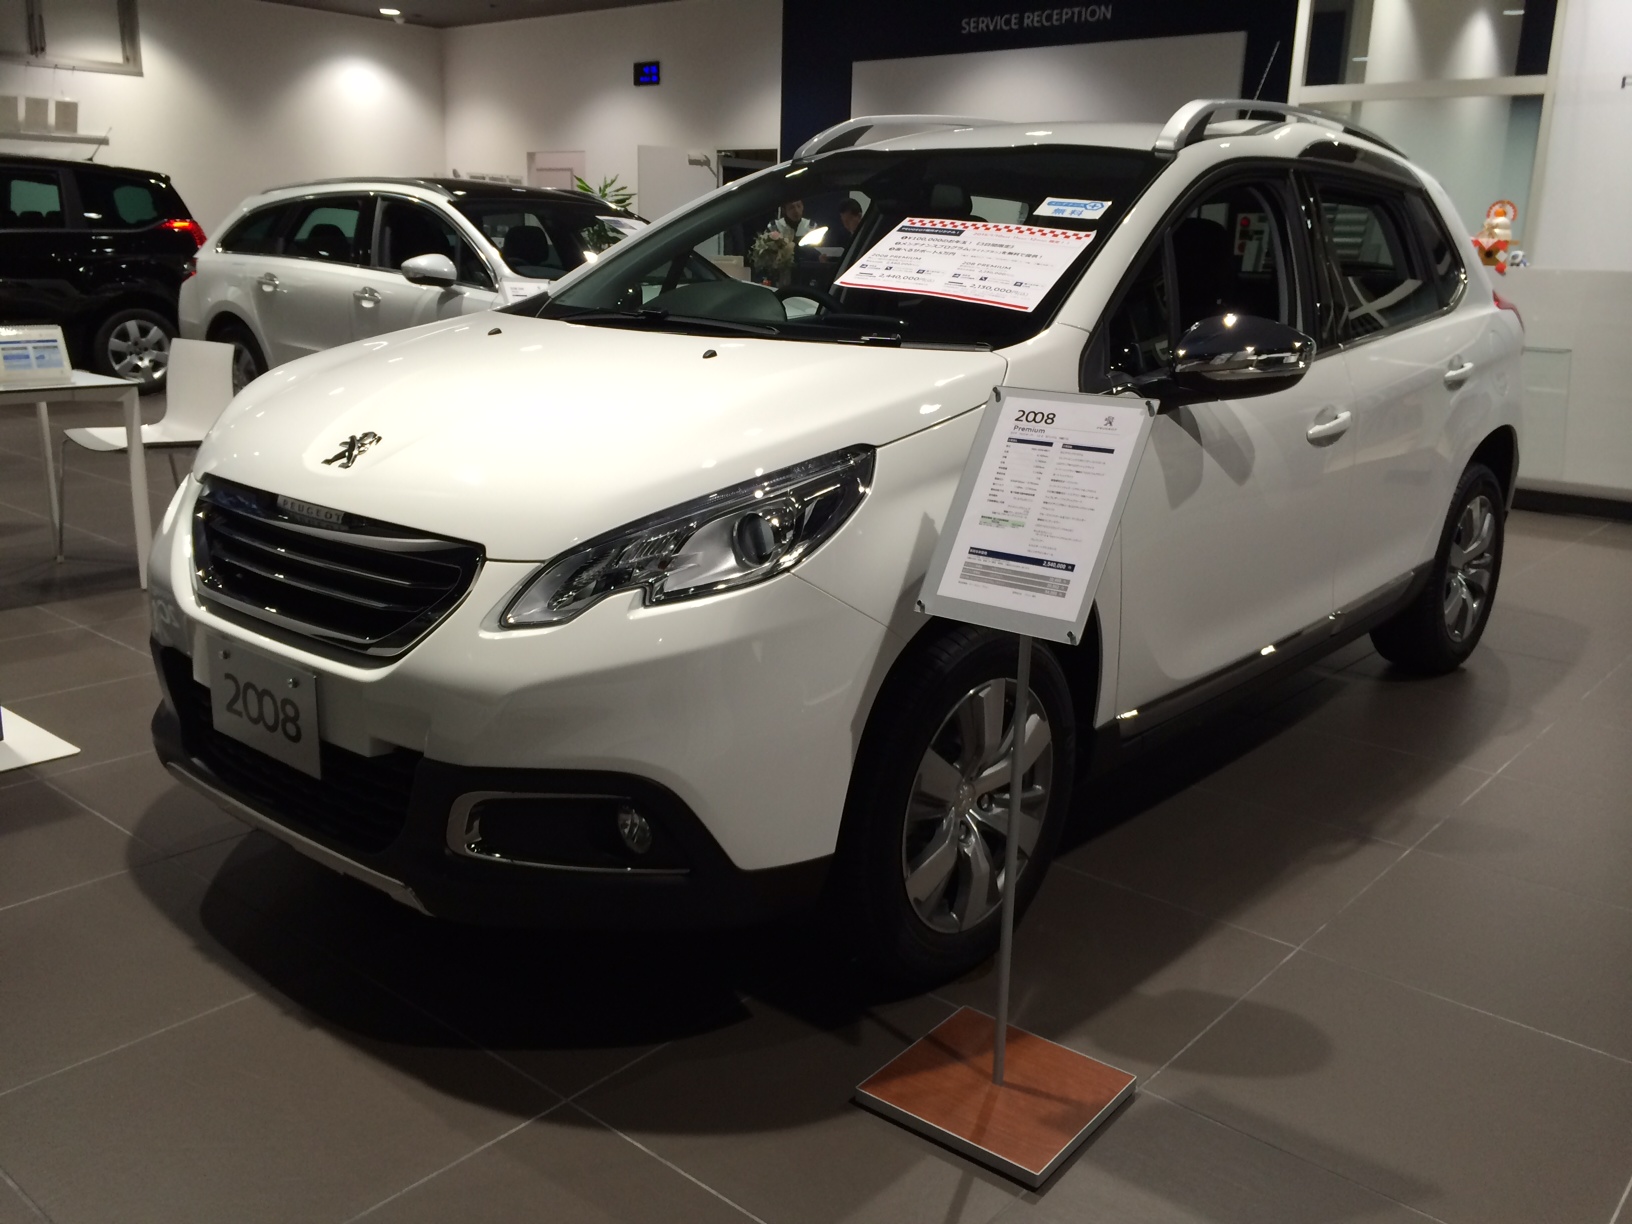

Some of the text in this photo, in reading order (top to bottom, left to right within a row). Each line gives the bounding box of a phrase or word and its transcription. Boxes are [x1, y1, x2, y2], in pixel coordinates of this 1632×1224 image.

[961, 4, 1113, 34] SERVICE RECEPTION
[977, 262, 1012, 270] PREMIUM
[1014, 409, 1056, 425] 2008
[1013, 425, 1046, 434] Premium
[282, 498, 342, 522] PEUGEOT
[224, 672, 302, 743] 2008
